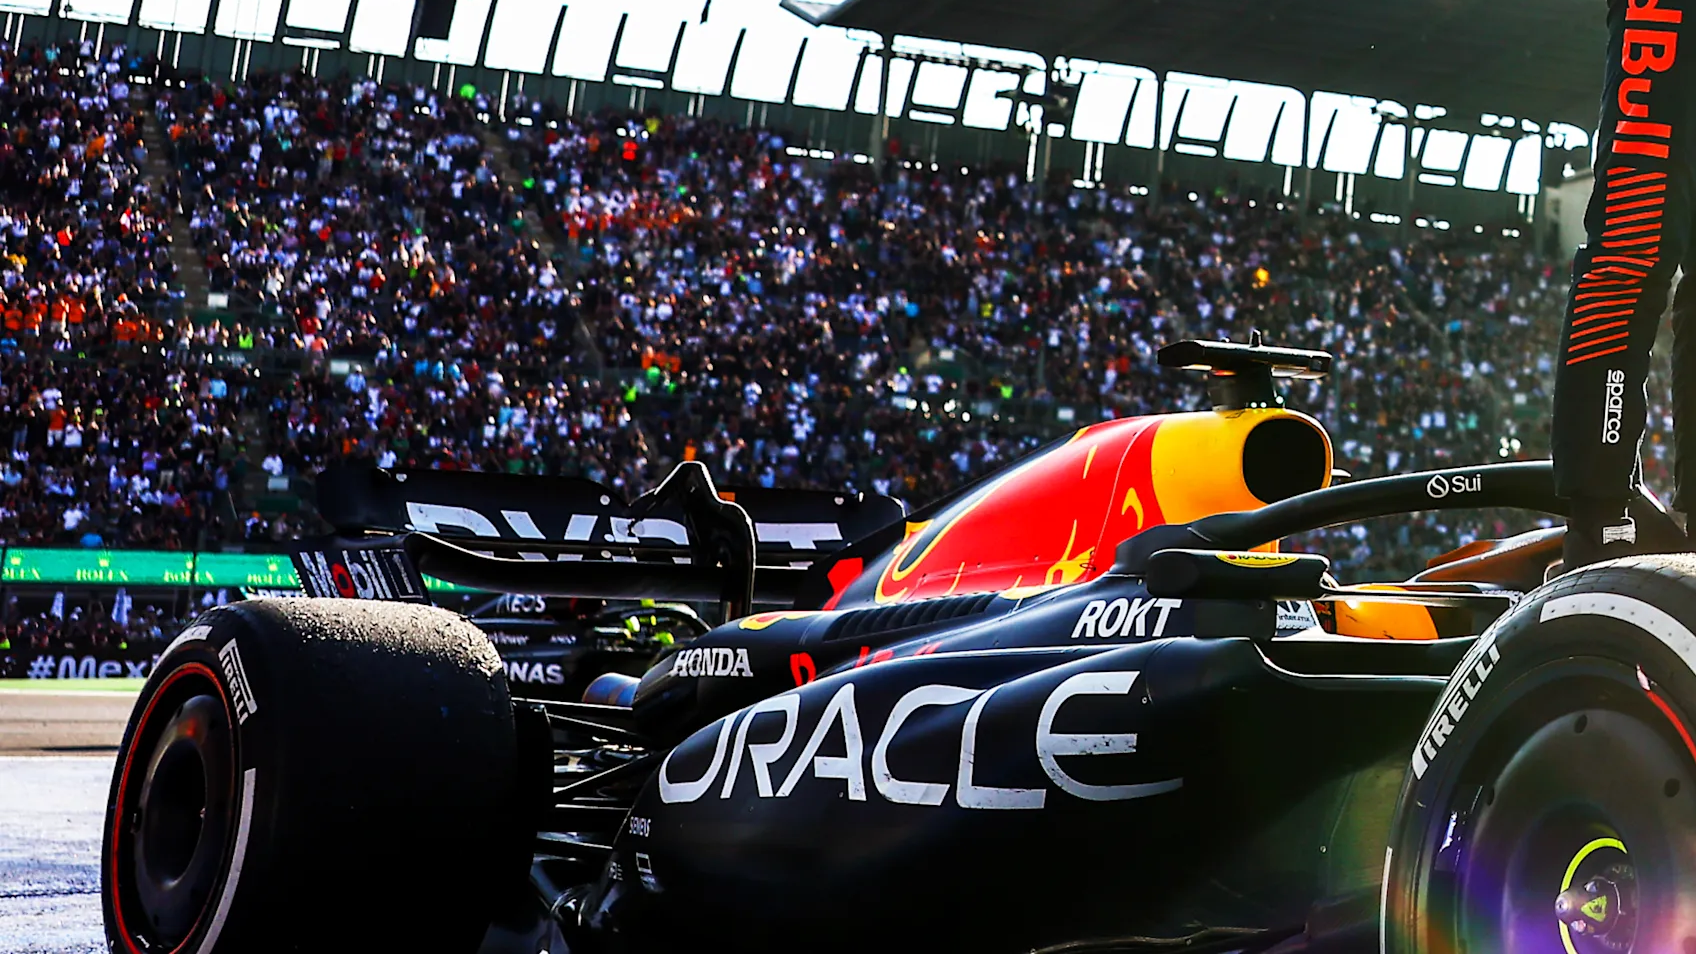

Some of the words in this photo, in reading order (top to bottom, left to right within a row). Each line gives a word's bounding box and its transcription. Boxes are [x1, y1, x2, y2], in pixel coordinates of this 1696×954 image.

[1602, 369, 1625, 444] sparco
[1452, 474, 1482, 493] Sui
[300, 550, 393, 600] Mobil
[1071, 598, 1182, 638] ROKT
[217, 638, 258, 726] PIRELLI
[673, 648, 754, 677] HONDA
[1411, 630, 1502, 780] PIRELLI
[659, 670, 1184, 810] ORACLE
